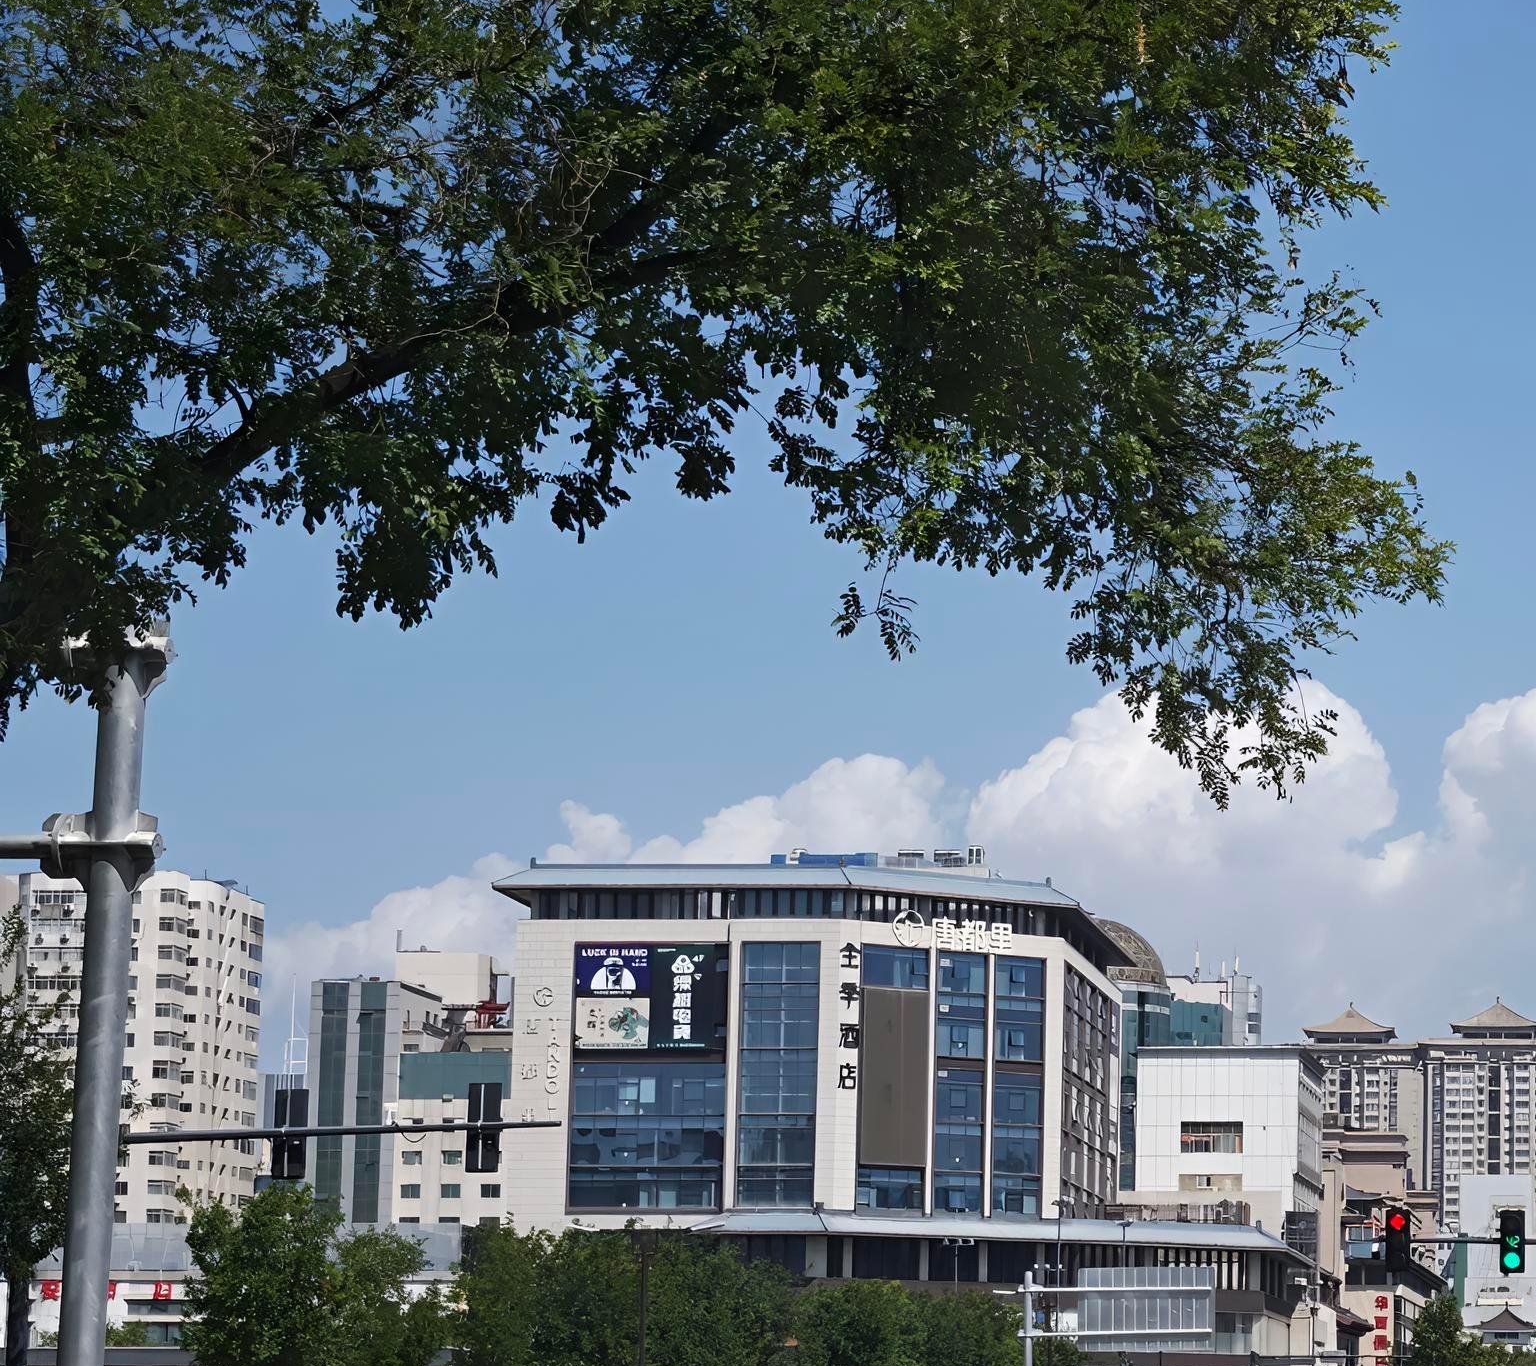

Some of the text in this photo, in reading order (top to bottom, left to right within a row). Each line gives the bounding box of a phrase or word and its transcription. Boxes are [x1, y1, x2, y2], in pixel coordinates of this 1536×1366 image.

[931, 916, 1012, 951] 唐都里
[838, 942, 860, 1090] 全季酒店
